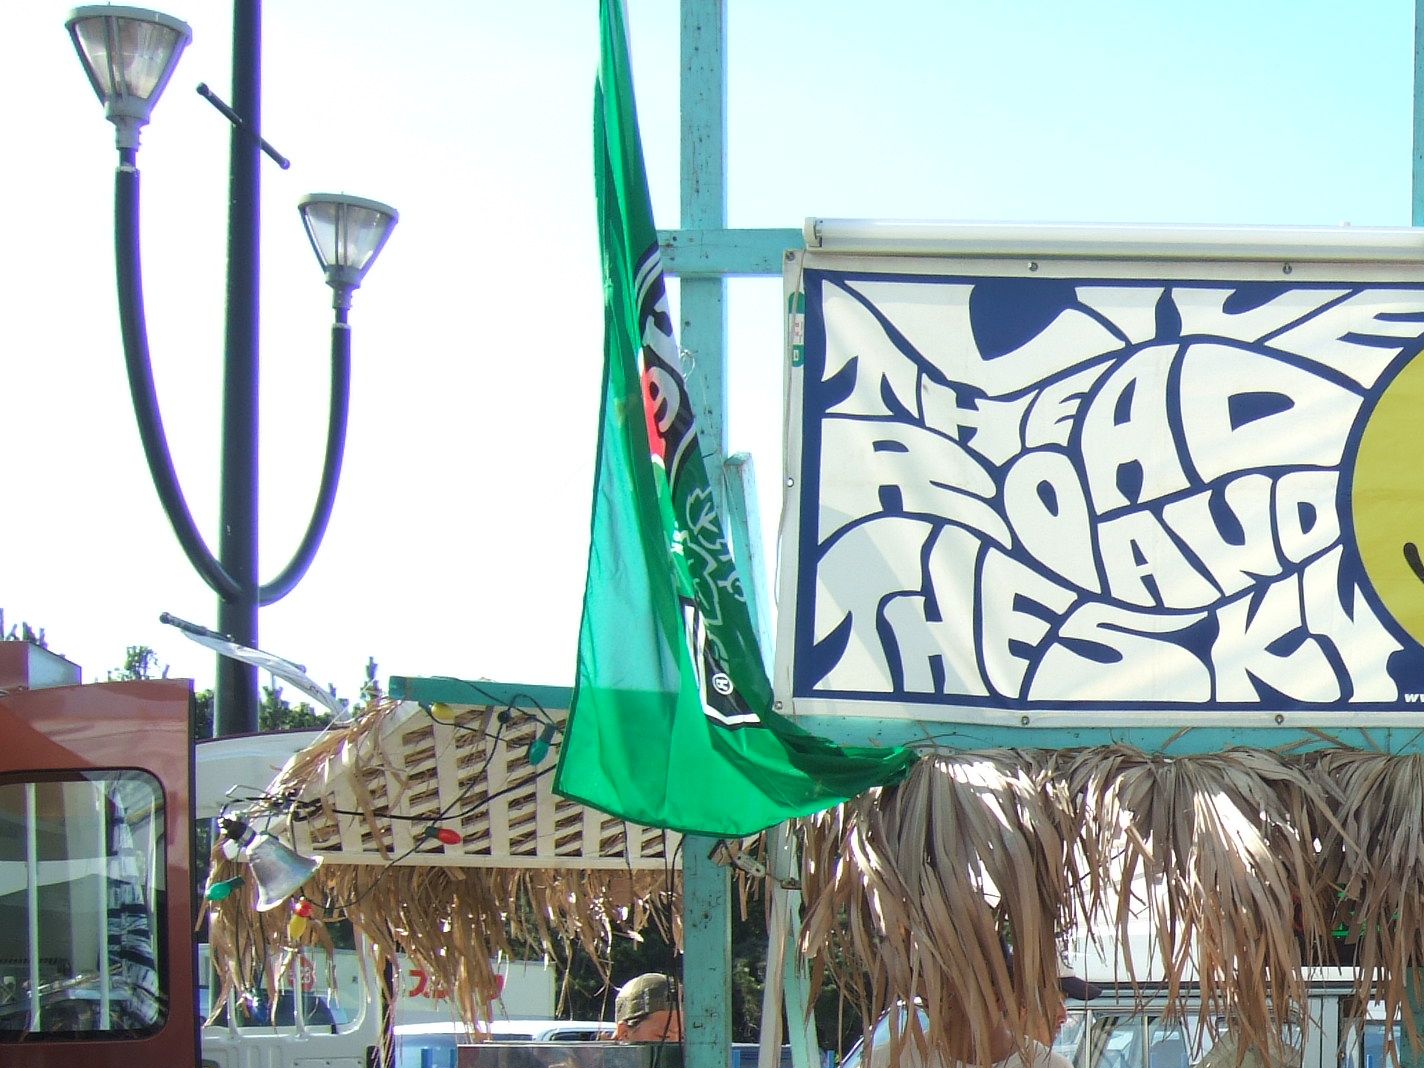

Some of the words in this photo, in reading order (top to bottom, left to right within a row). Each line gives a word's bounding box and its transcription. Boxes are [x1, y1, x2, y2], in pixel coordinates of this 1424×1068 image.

[822, 281, 1120, 466] THE
[819, 343, 1365, 594] ROAD
[1097, 471, 1340, 609] AND
[814, 517, 1078, 699] THE
[1025, 545, 1404, 703] SKY
